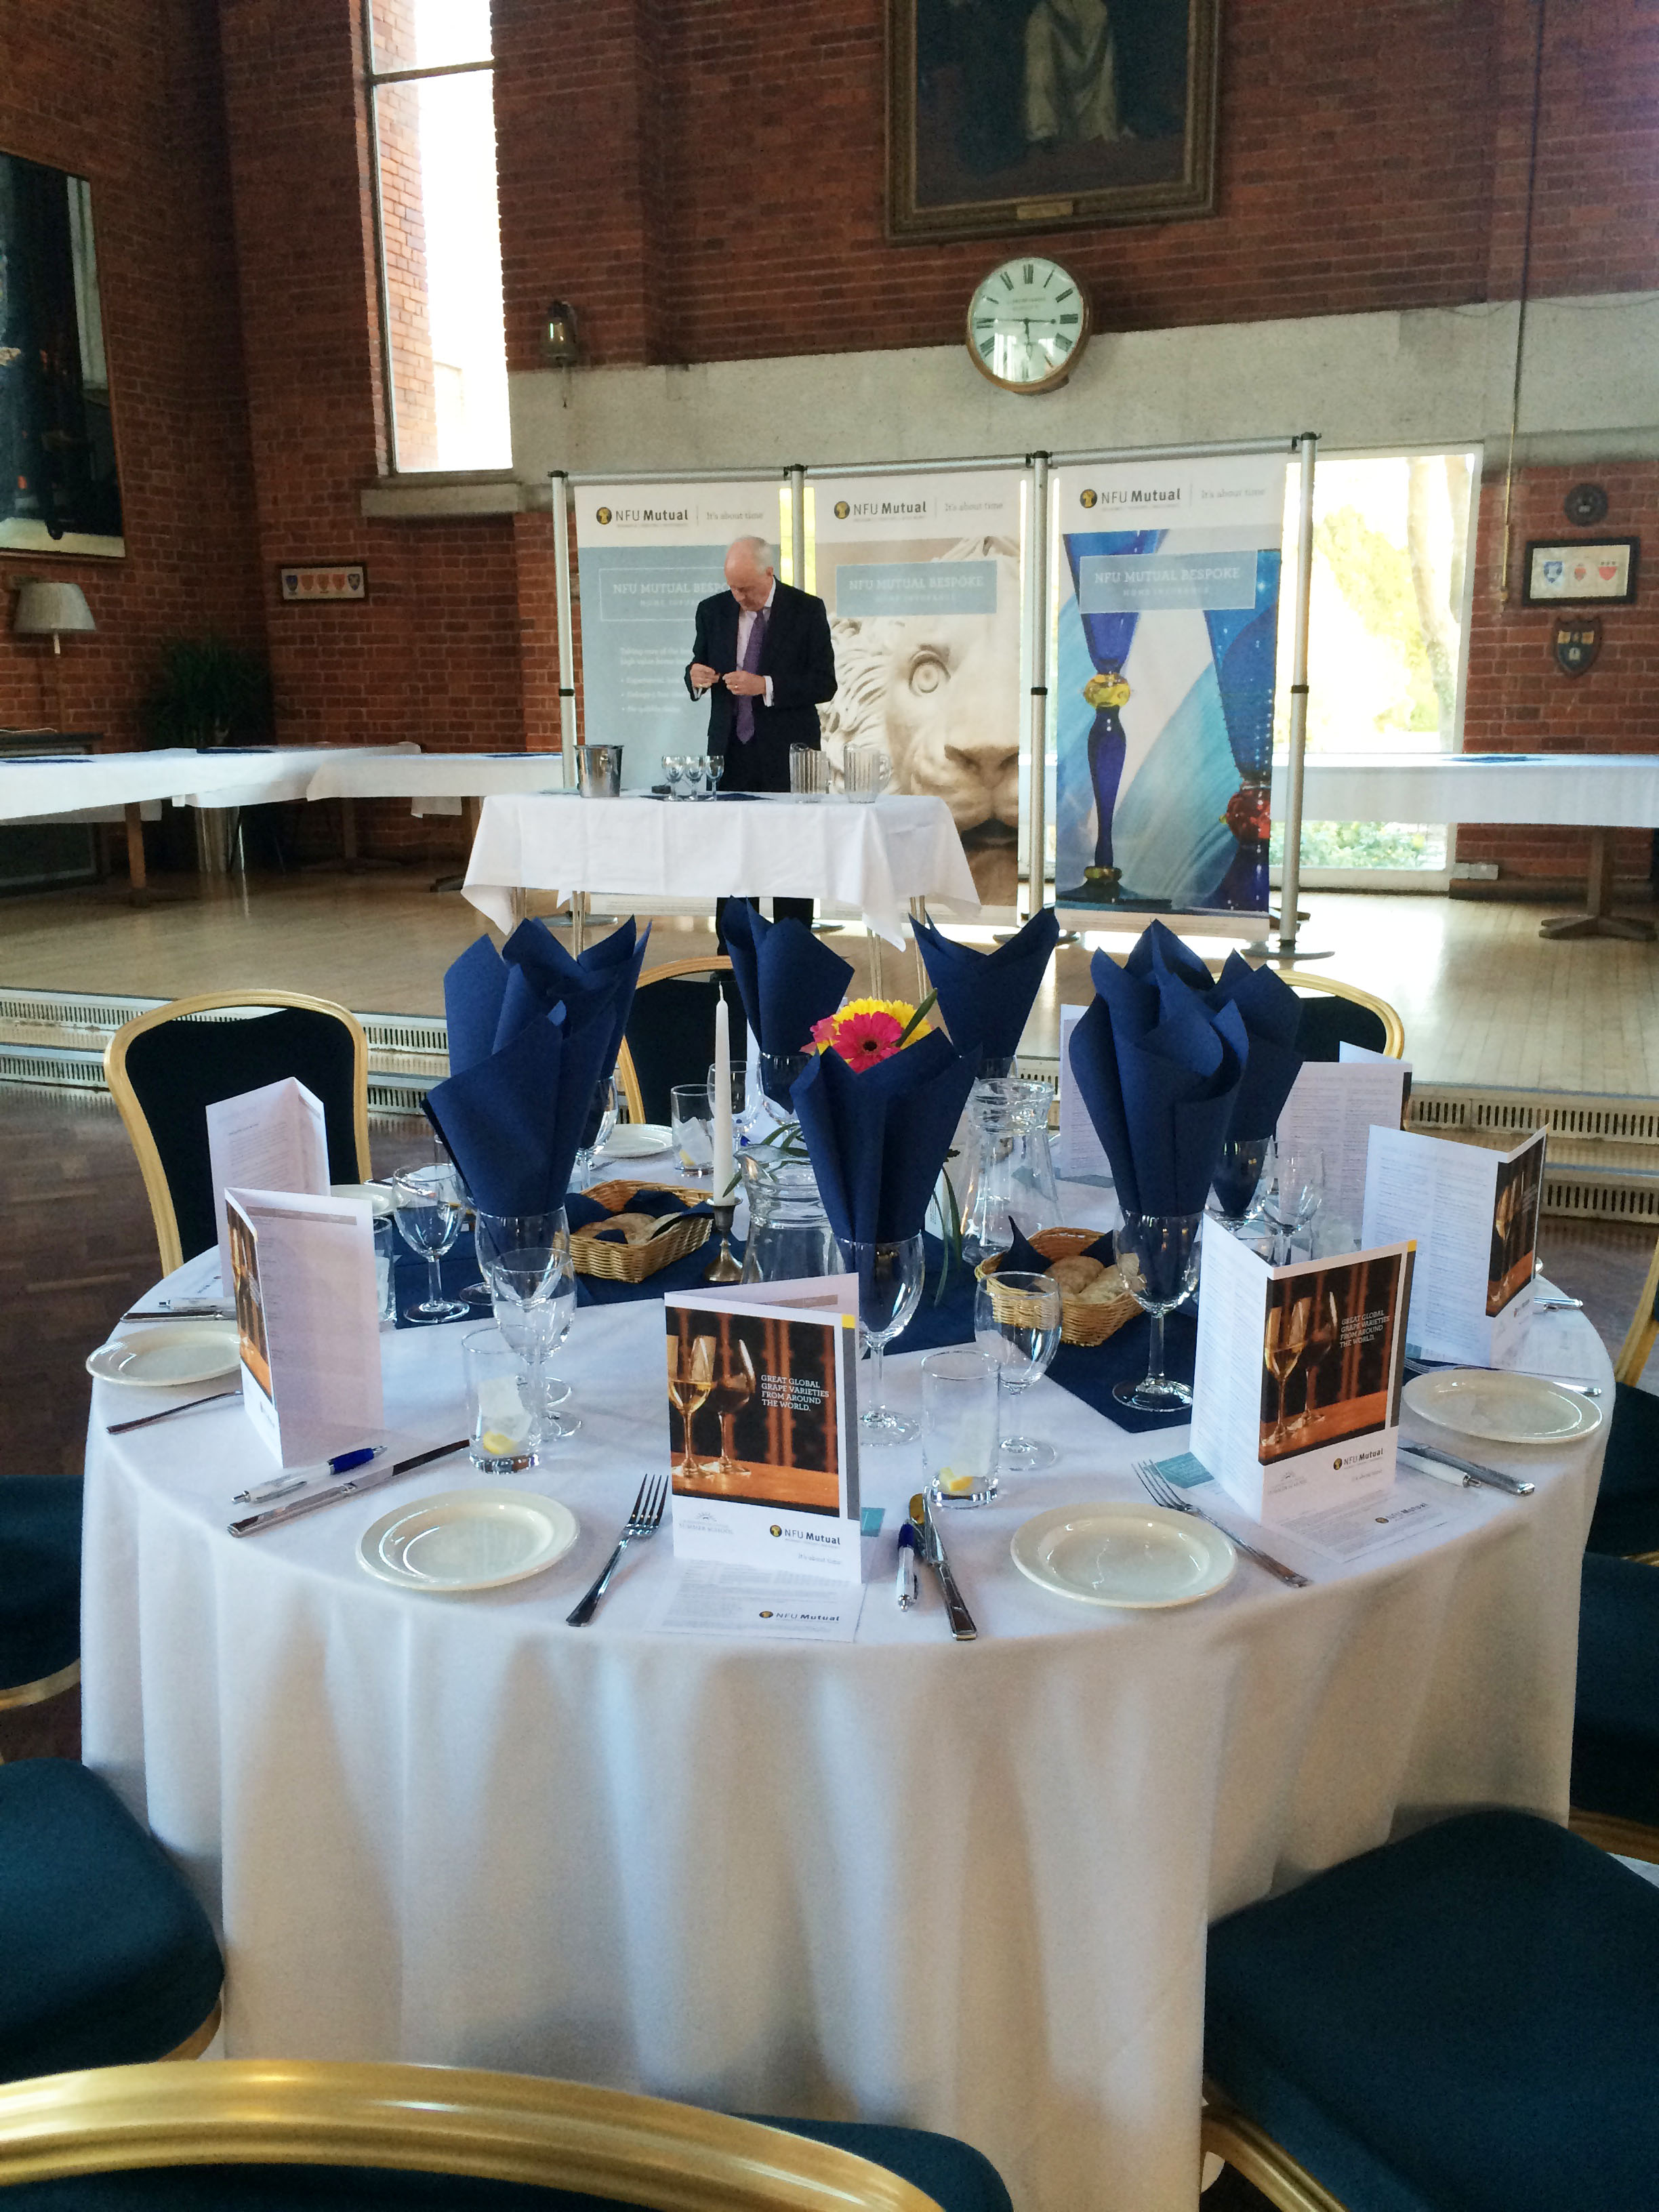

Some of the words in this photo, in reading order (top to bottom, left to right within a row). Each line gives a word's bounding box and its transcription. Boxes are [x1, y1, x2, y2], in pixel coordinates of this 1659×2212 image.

[1101, 491, 1127, 504] NFU
[1131, 488, 1181, 502] Mutual
[615, 510, 640, 521] NFU
[644, 509, 688, 521] Mutual
[720, 511, 743, 520] about
[854, 504, 878, 515] NFU
[882, 501, 926, 514] Mutual
[1094, 572, 1120, 583] NFU
[1124, 570, 1177, 582] MUTUAL
[1181, 567, 1240, 581] BESPOKE
[613, 583, 638, 594] NFU
[641, 583, 691, 594] MUTUAL
[693, 582, 731, 594] BESPO
[849, 579, 873, 591] NFU
[876, 577, 926, 590] MUTUAL
[929, 575, 983, 588] BESPOKE
[1340, 1323, 1361, 1333] GRAPE
[1361, 1315, 1391, 1328] VARIETIES
[1342, 1315, 1361, 1325] GREAT
[1361, 1310, 1385, 1321] GLOBAL
[1340, 1330, 1357, 1340] FROM
[1357, 1325, 1384, 1337] AROUND
[1339, 1339, 1352, 1349] THE
[760, 1374, 787, 1384] GREAT
[788, 1378, 821, 1389] GLOBAL
[761, 1382, 787, 1392] GRAPE
[789, 1386, 830, 1397] VARIETIES
[761, 1398, 779, 1407] THE
[779, 1400, 811, 1412] WORLD.
[762, 1391, 785, 1399] FROM
[786, 1393, 821, 1404] AROUND
[1344, 1456, 1358, 1465] NFU
[1359, 1448, 1384, 1461] Mutual
[785, 1528, 804, 1539] NFU
[806, 1532, 841, 1545] Mutual
[800, 1614, 840, 1622] Mutual
